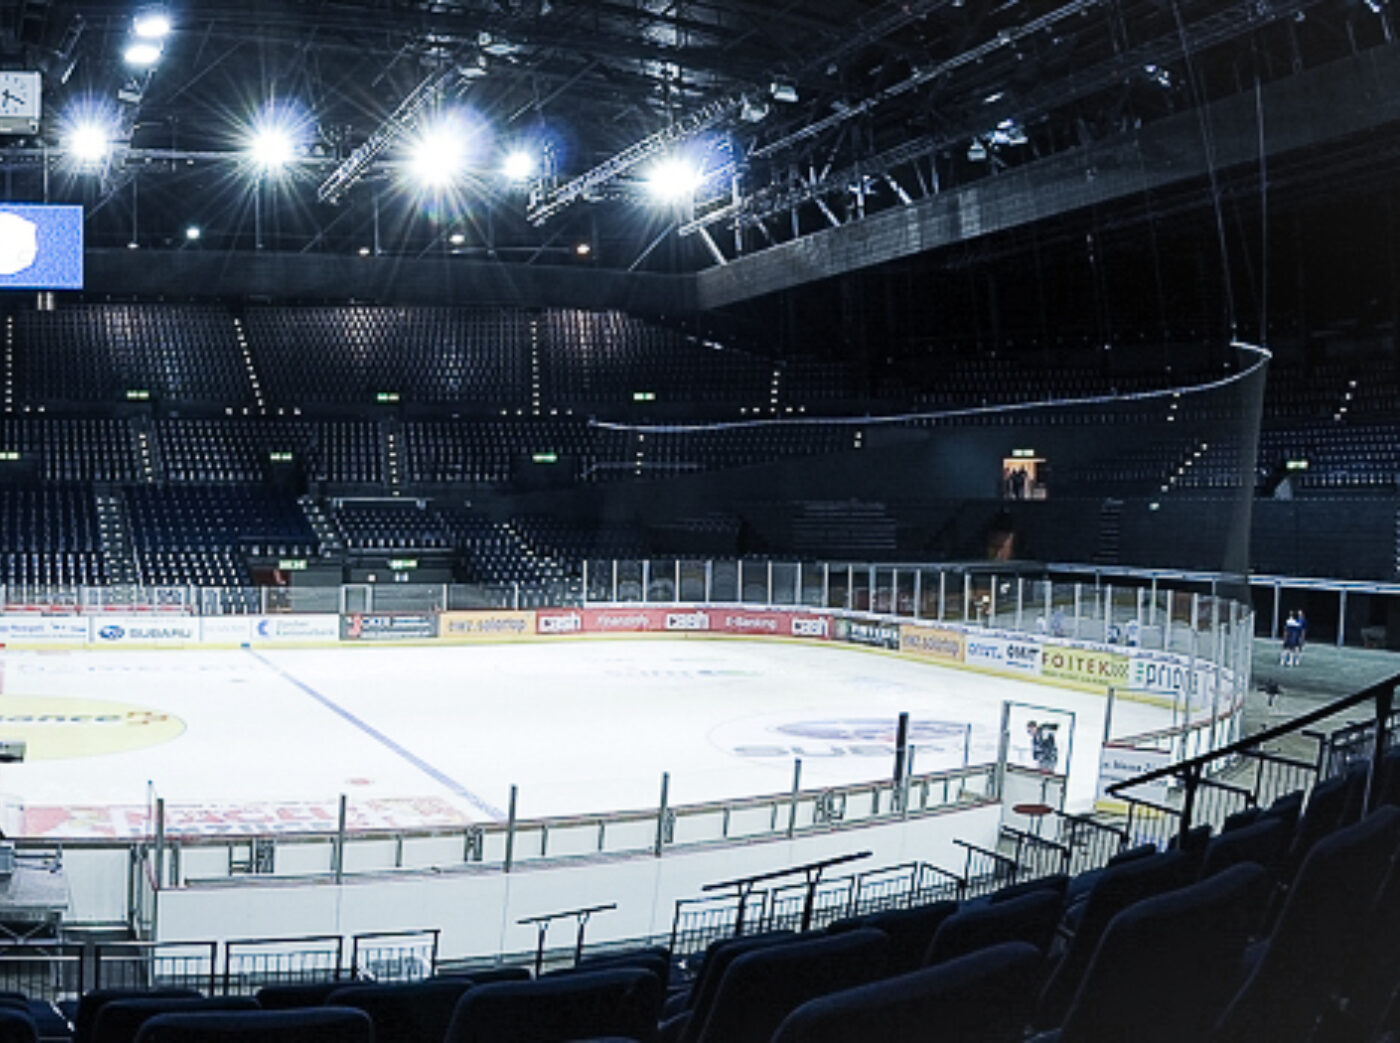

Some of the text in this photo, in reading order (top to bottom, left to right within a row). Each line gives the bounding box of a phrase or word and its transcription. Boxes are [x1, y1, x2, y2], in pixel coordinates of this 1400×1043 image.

[667, 610, 709, 630] cash
[792, 616, 828, 636] cash
[129, 628, 193, 638] SUBARU
[1042, 652, 1112, 678] FOITEK
